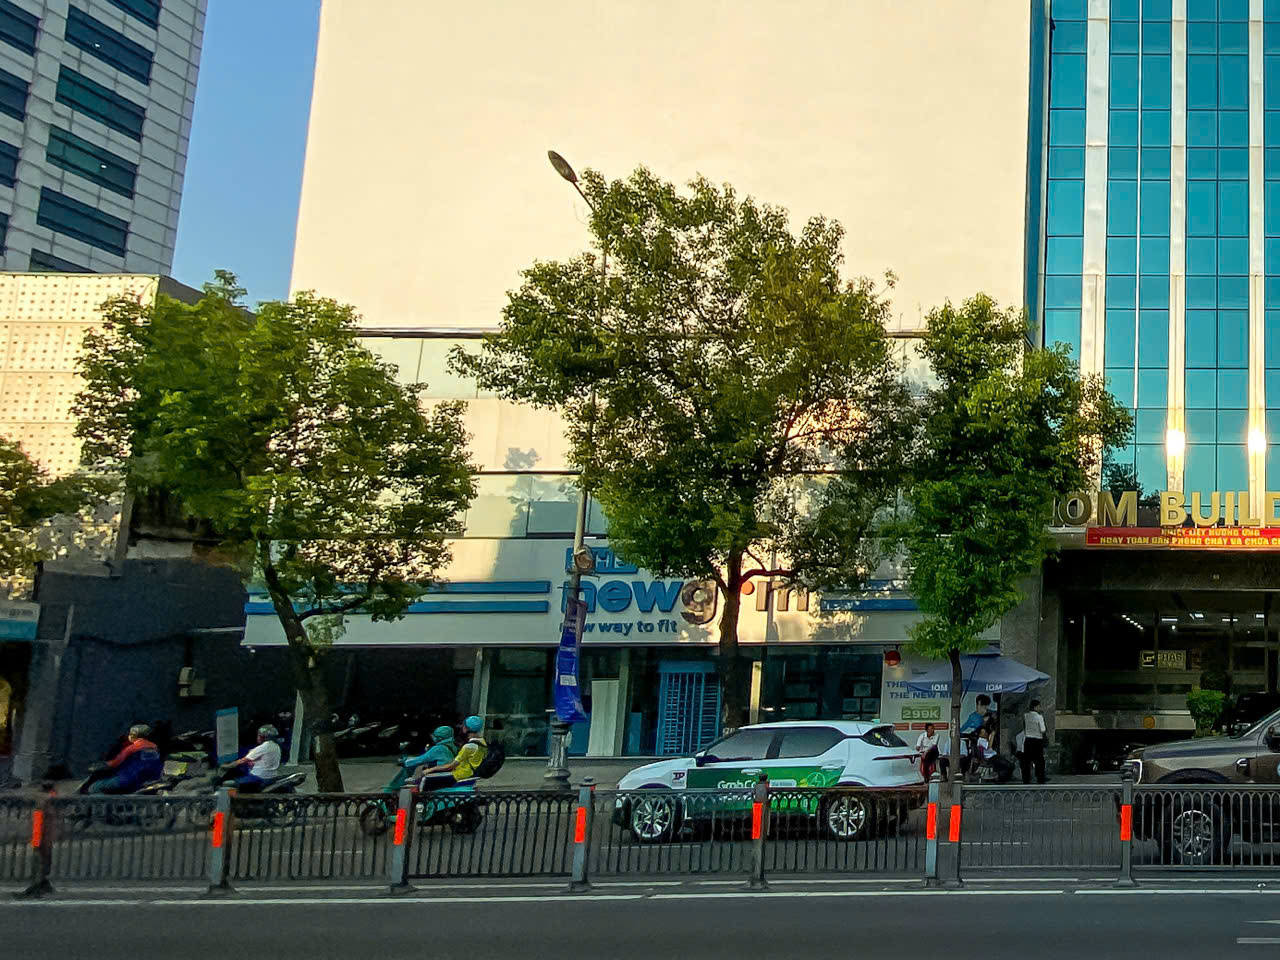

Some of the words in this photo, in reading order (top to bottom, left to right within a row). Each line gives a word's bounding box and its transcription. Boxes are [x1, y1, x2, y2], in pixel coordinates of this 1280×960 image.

[1050, 491, 1138, 526] OM
[598, 622, 633, 635] way
[637, 620, 655, 633] to
[657, 619, 678, 633] fit
[903, 709, 939, 719] 299K
